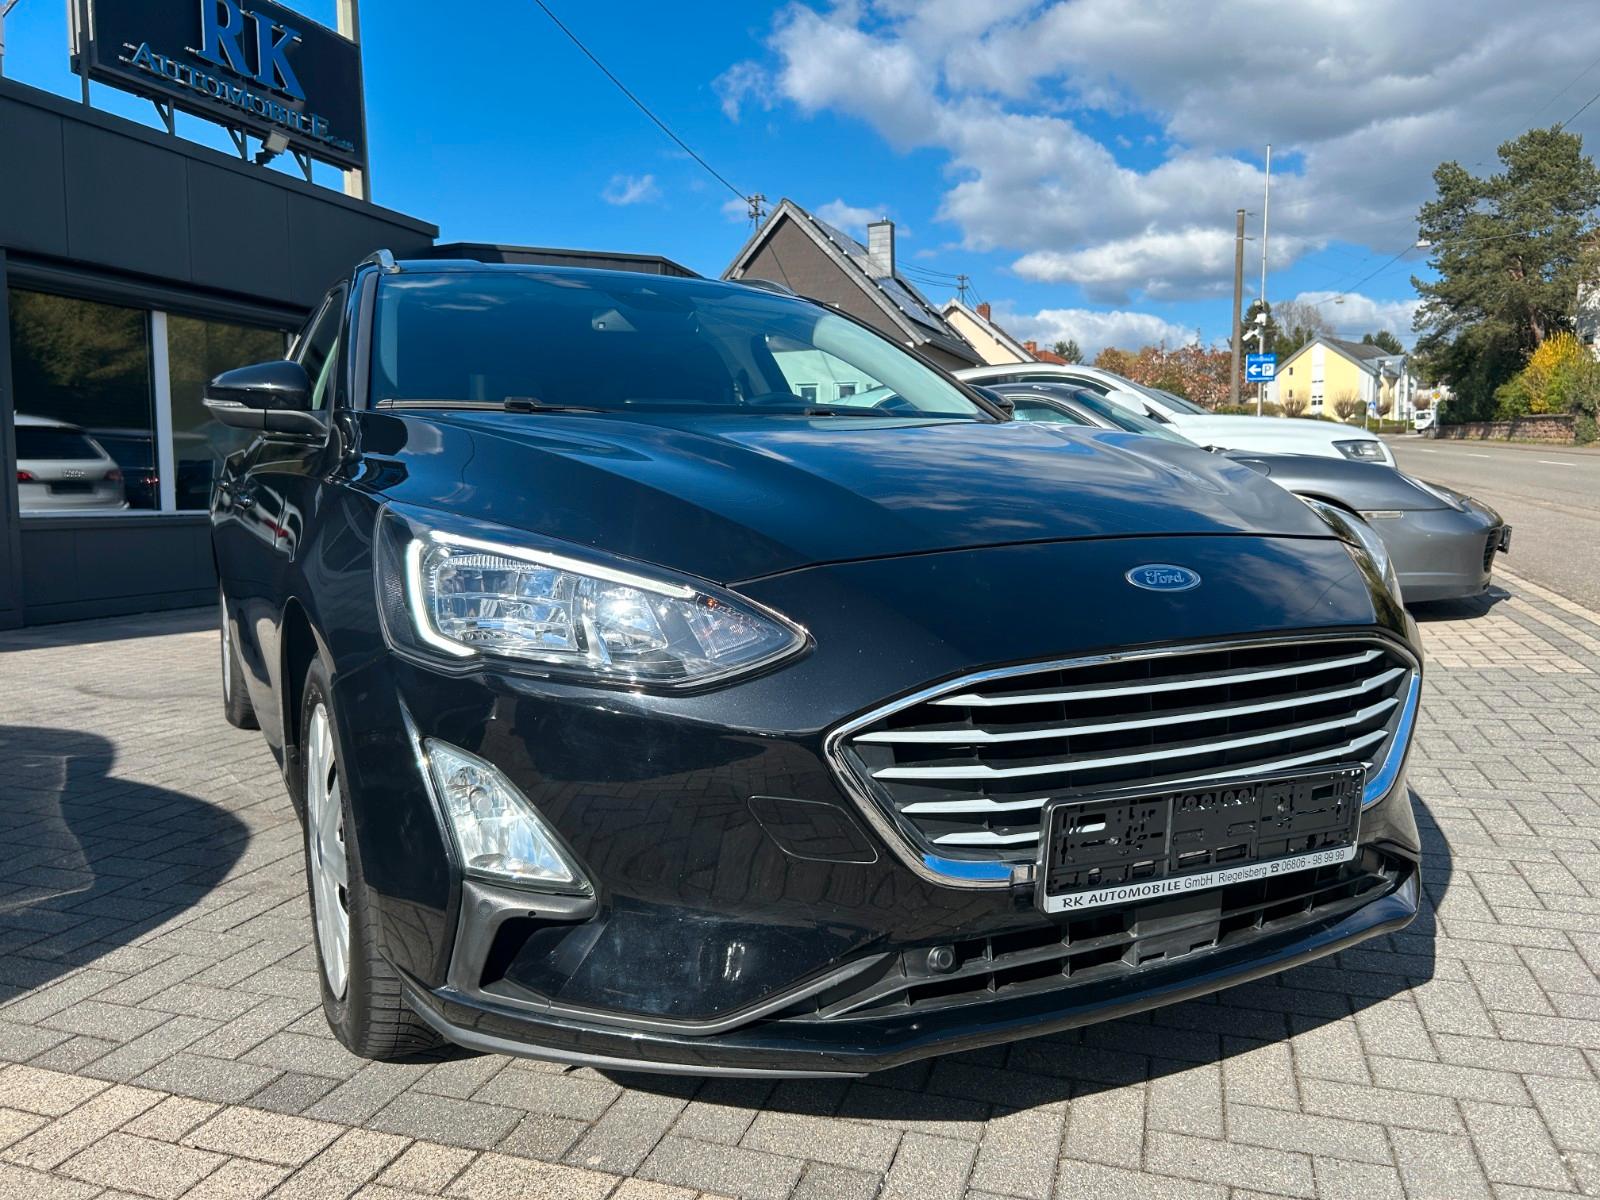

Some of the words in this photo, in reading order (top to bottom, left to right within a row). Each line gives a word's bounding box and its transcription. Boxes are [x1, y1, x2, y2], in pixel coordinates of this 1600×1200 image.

[184, 0, 306, 101] RK
[1144, 569, 1185, 585] Ford
[1062, 895, 1084, 908] RK
[1088, 880, 1181, 905] AUTOMOBILE
[1184, 874, 1213, 889] GmbH
[1218, 865, 1267, 884] Riegelsberg
[1281, 858, 1306, 872] 06806
[1312, 854, 1323, 865] 98
[1323, 852, 1334, 863] 99
[1335, 850, 1345, 860] 99
